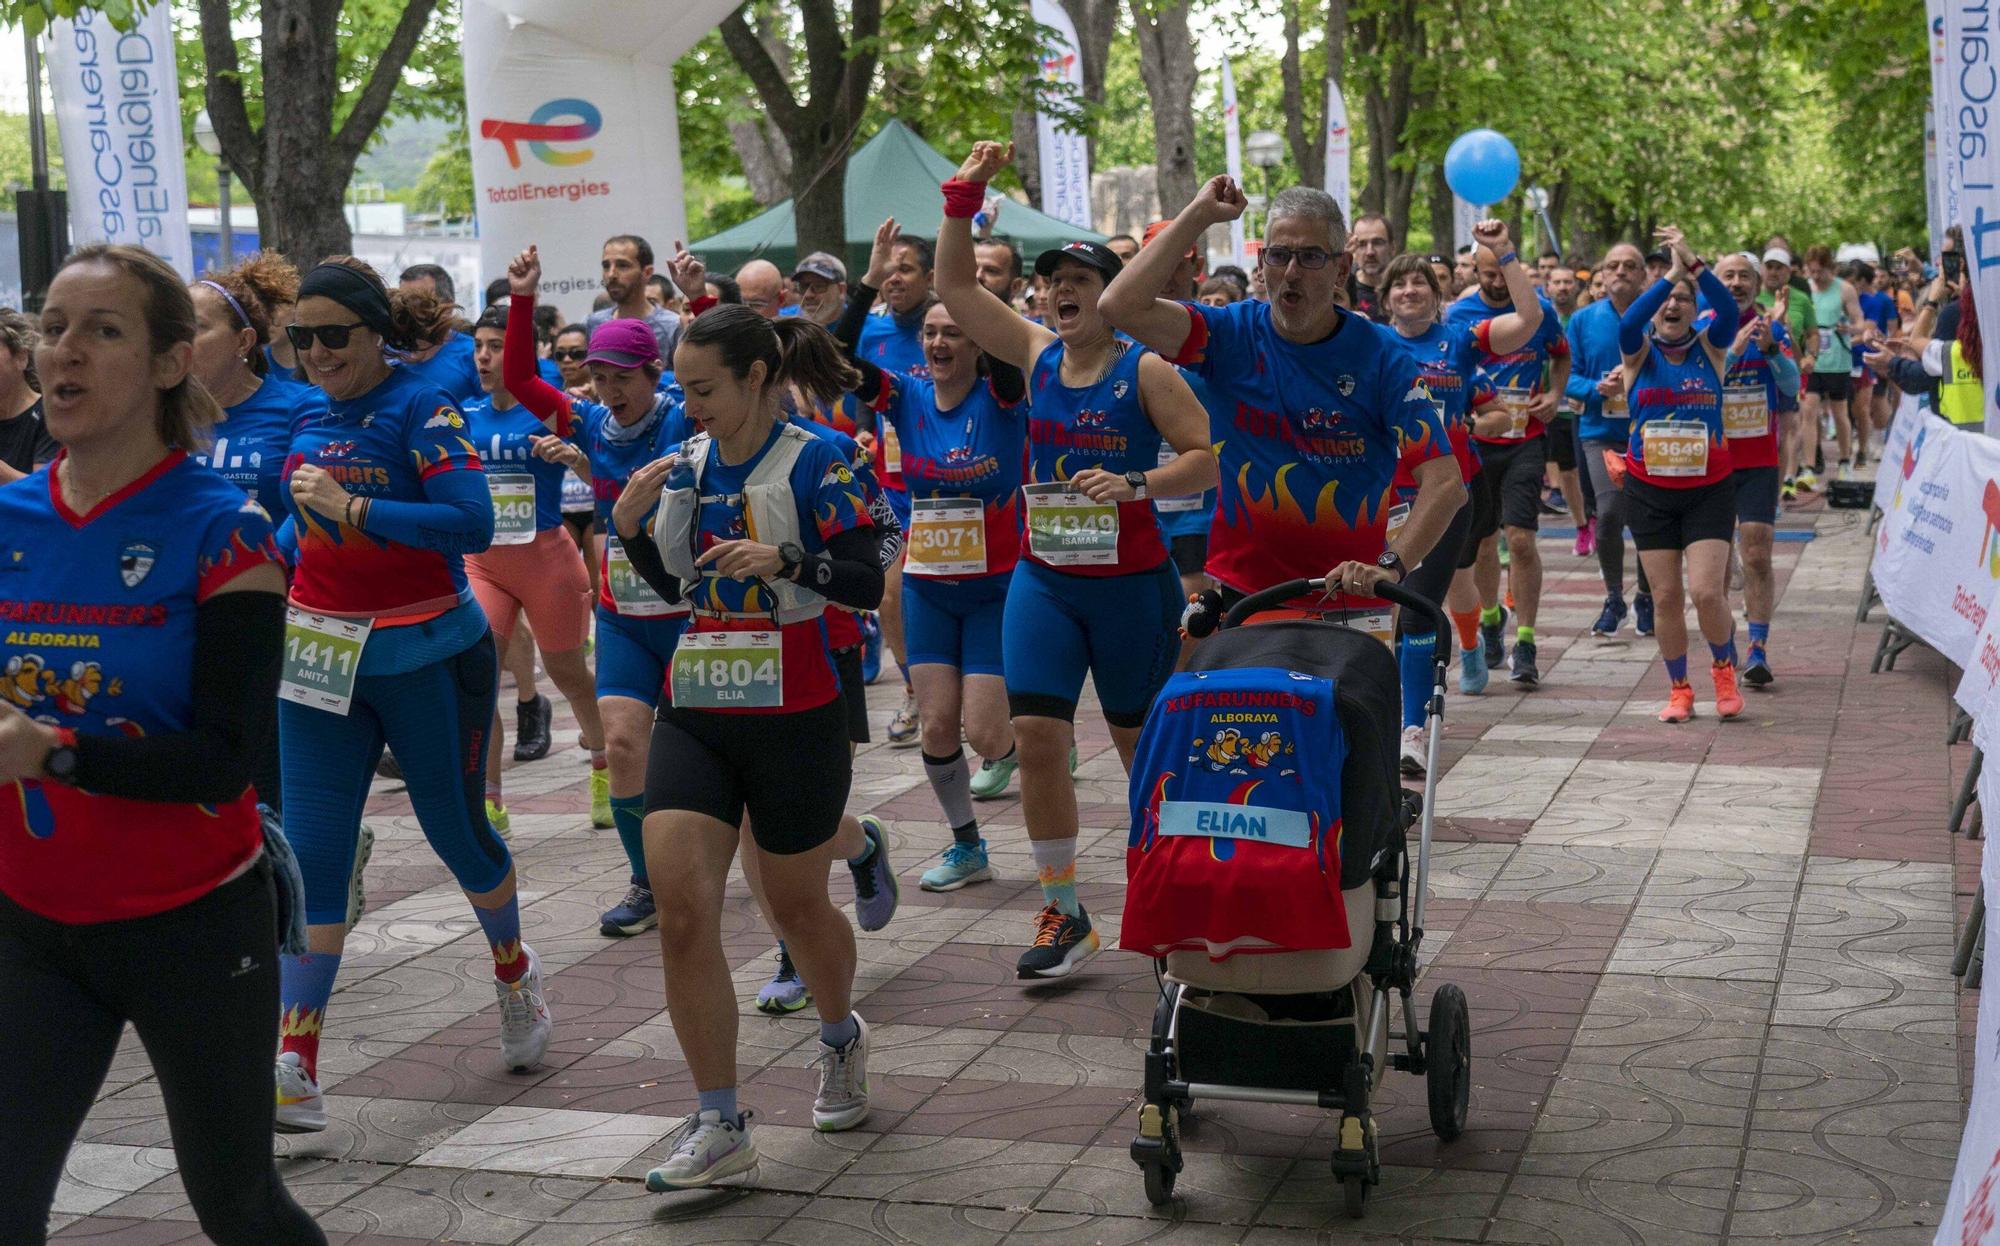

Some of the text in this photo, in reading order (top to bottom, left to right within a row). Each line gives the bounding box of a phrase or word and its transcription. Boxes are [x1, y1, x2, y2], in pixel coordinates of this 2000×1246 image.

[486, 179, 611, 204] TotalEnergies
[1658, 441, 1704, 457] 3649
[1049, 514, 1116, 536] 1349
[922, 526, 979, 549] 3071
[1061, 537, 1099, 546] ISAMAR
[5, 631, 100, 648] ALBORAYA
[288, 636, 353, 676] 1411
[298, 668, 329, 685] ANITA
[693, 658, 777, 687] 1804
[717, 690, 745, 700] ELIA
[1165, 690, 1317, 718] XUFARUNNERS
[1210, 713, 1280, 724] ALBORAYA
[1196, 810, 1268, 838] ELIAN
